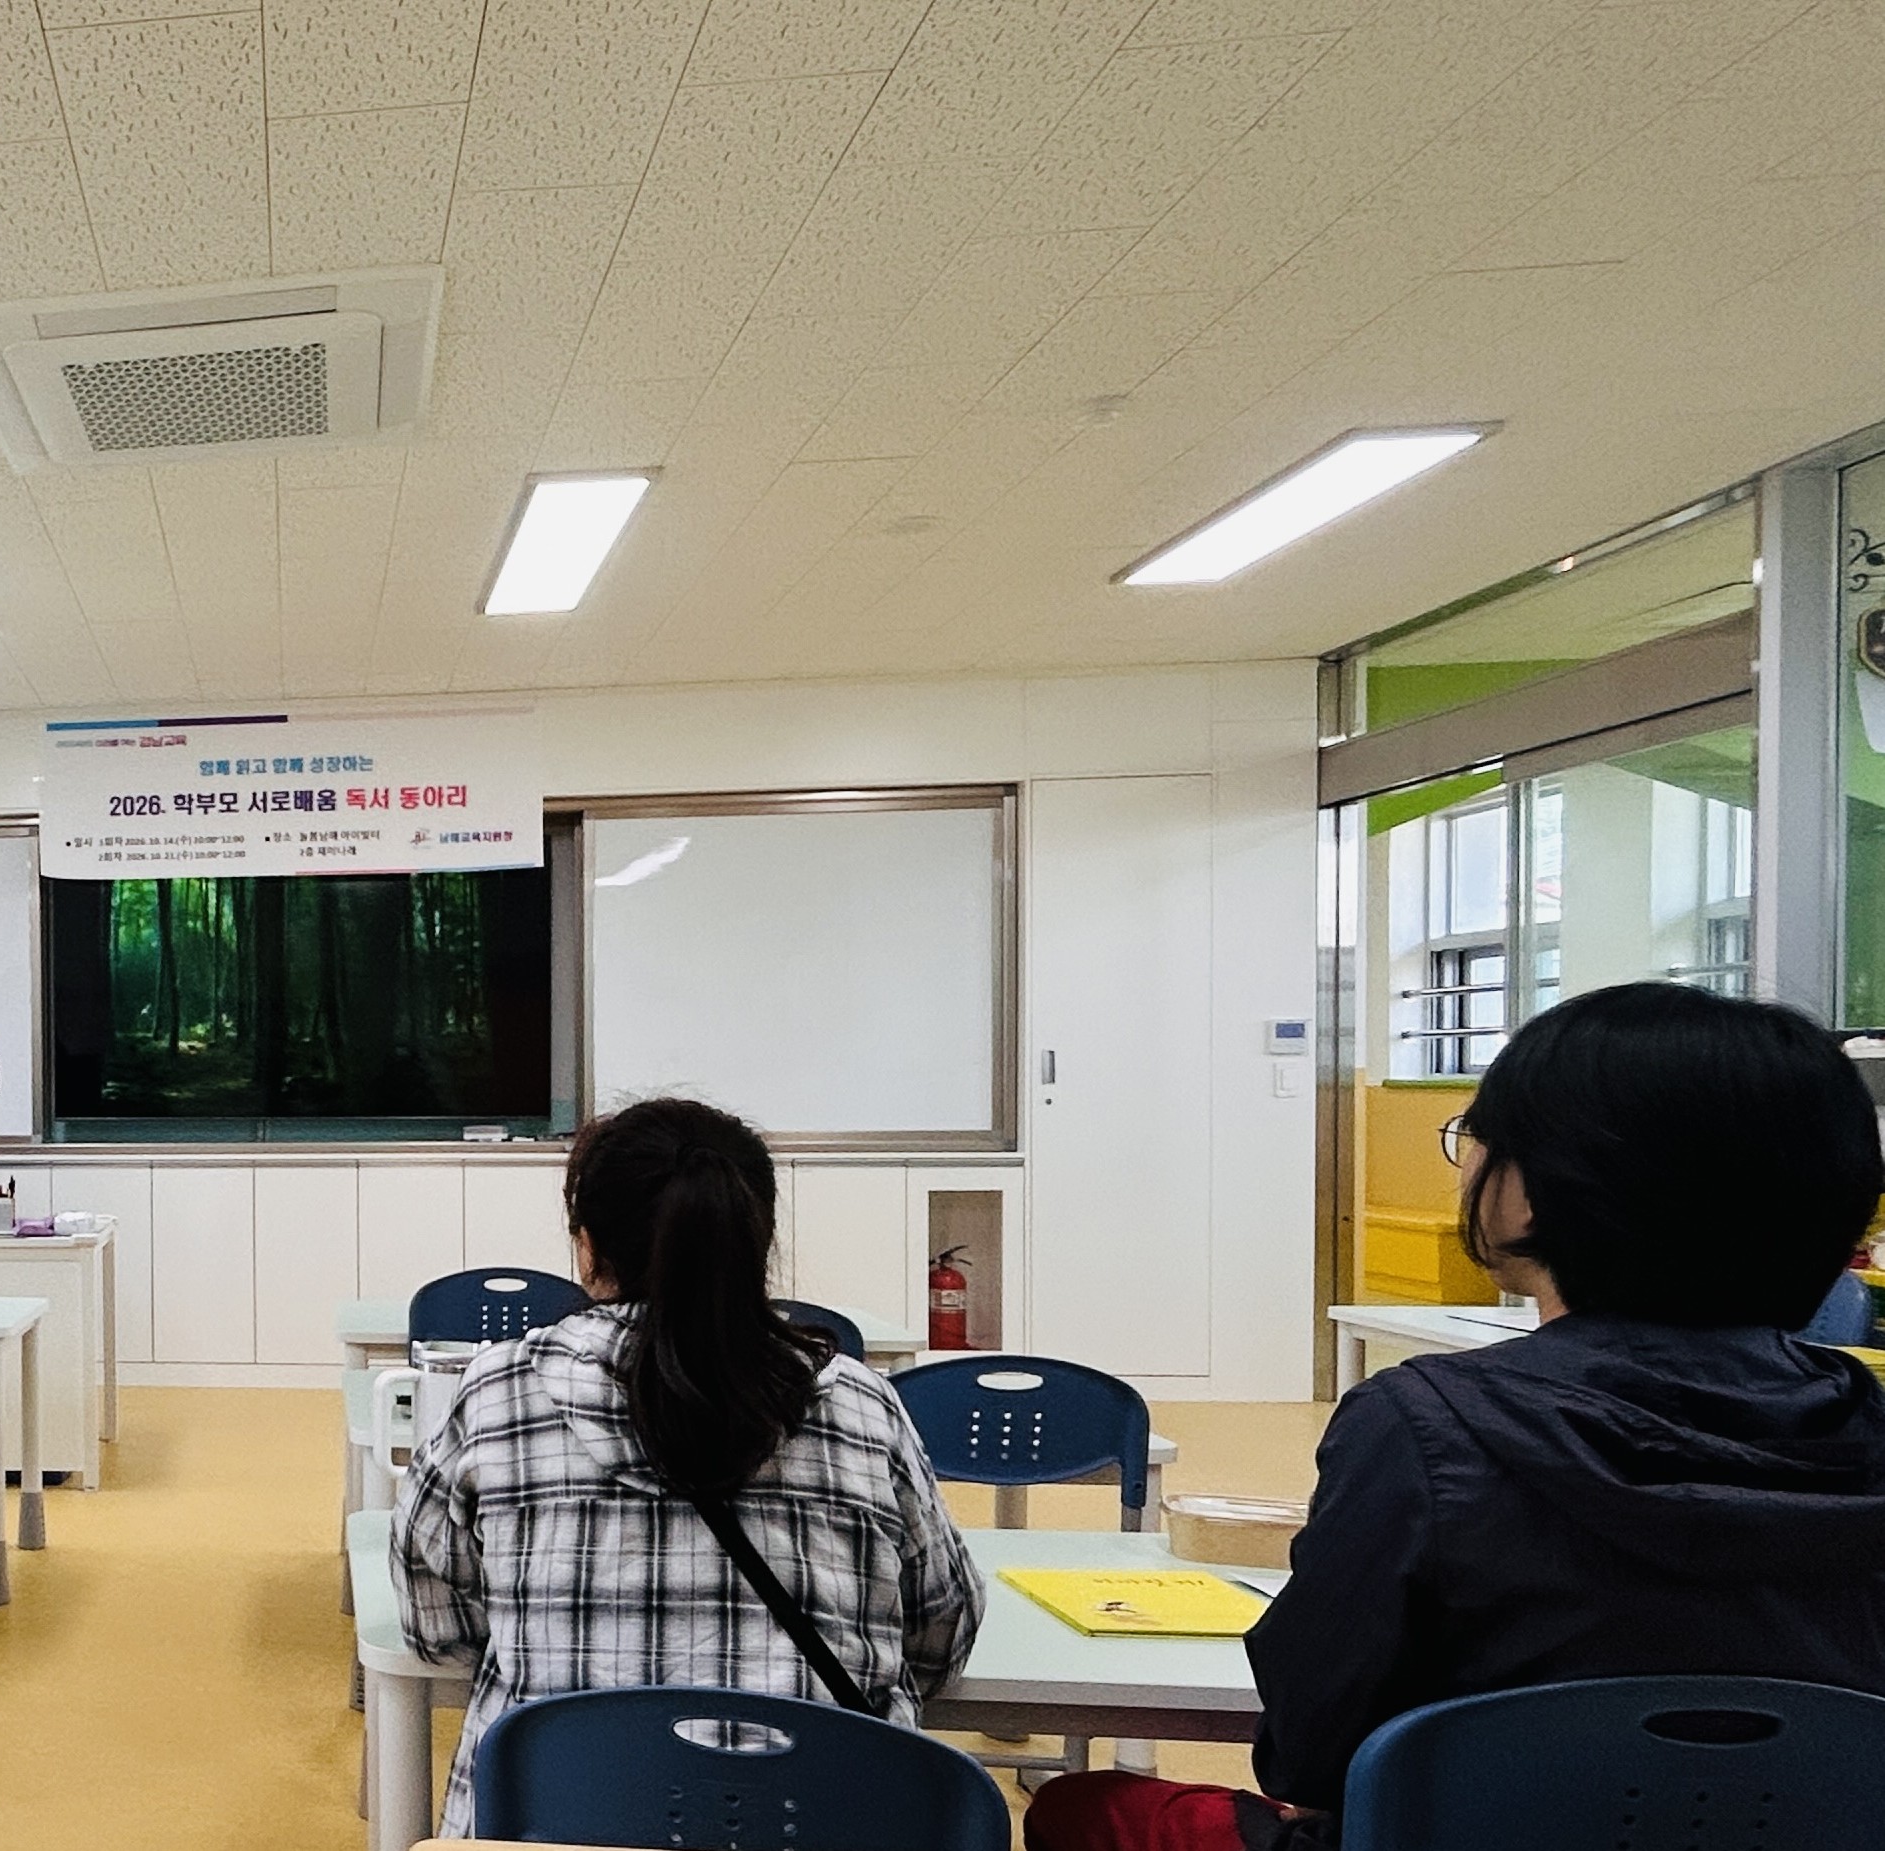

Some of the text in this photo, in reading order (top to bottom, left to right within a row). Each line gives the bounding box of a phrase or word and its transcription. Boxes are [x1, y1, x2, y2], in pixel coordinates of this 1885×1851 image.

[199, 755, 374, 776] 함께 읽고 함께 성장하는
[109, 784, 468, 817] 2026. 학부모 서로배움 독서 동아리
[273, 832, 292, 842] 장소
